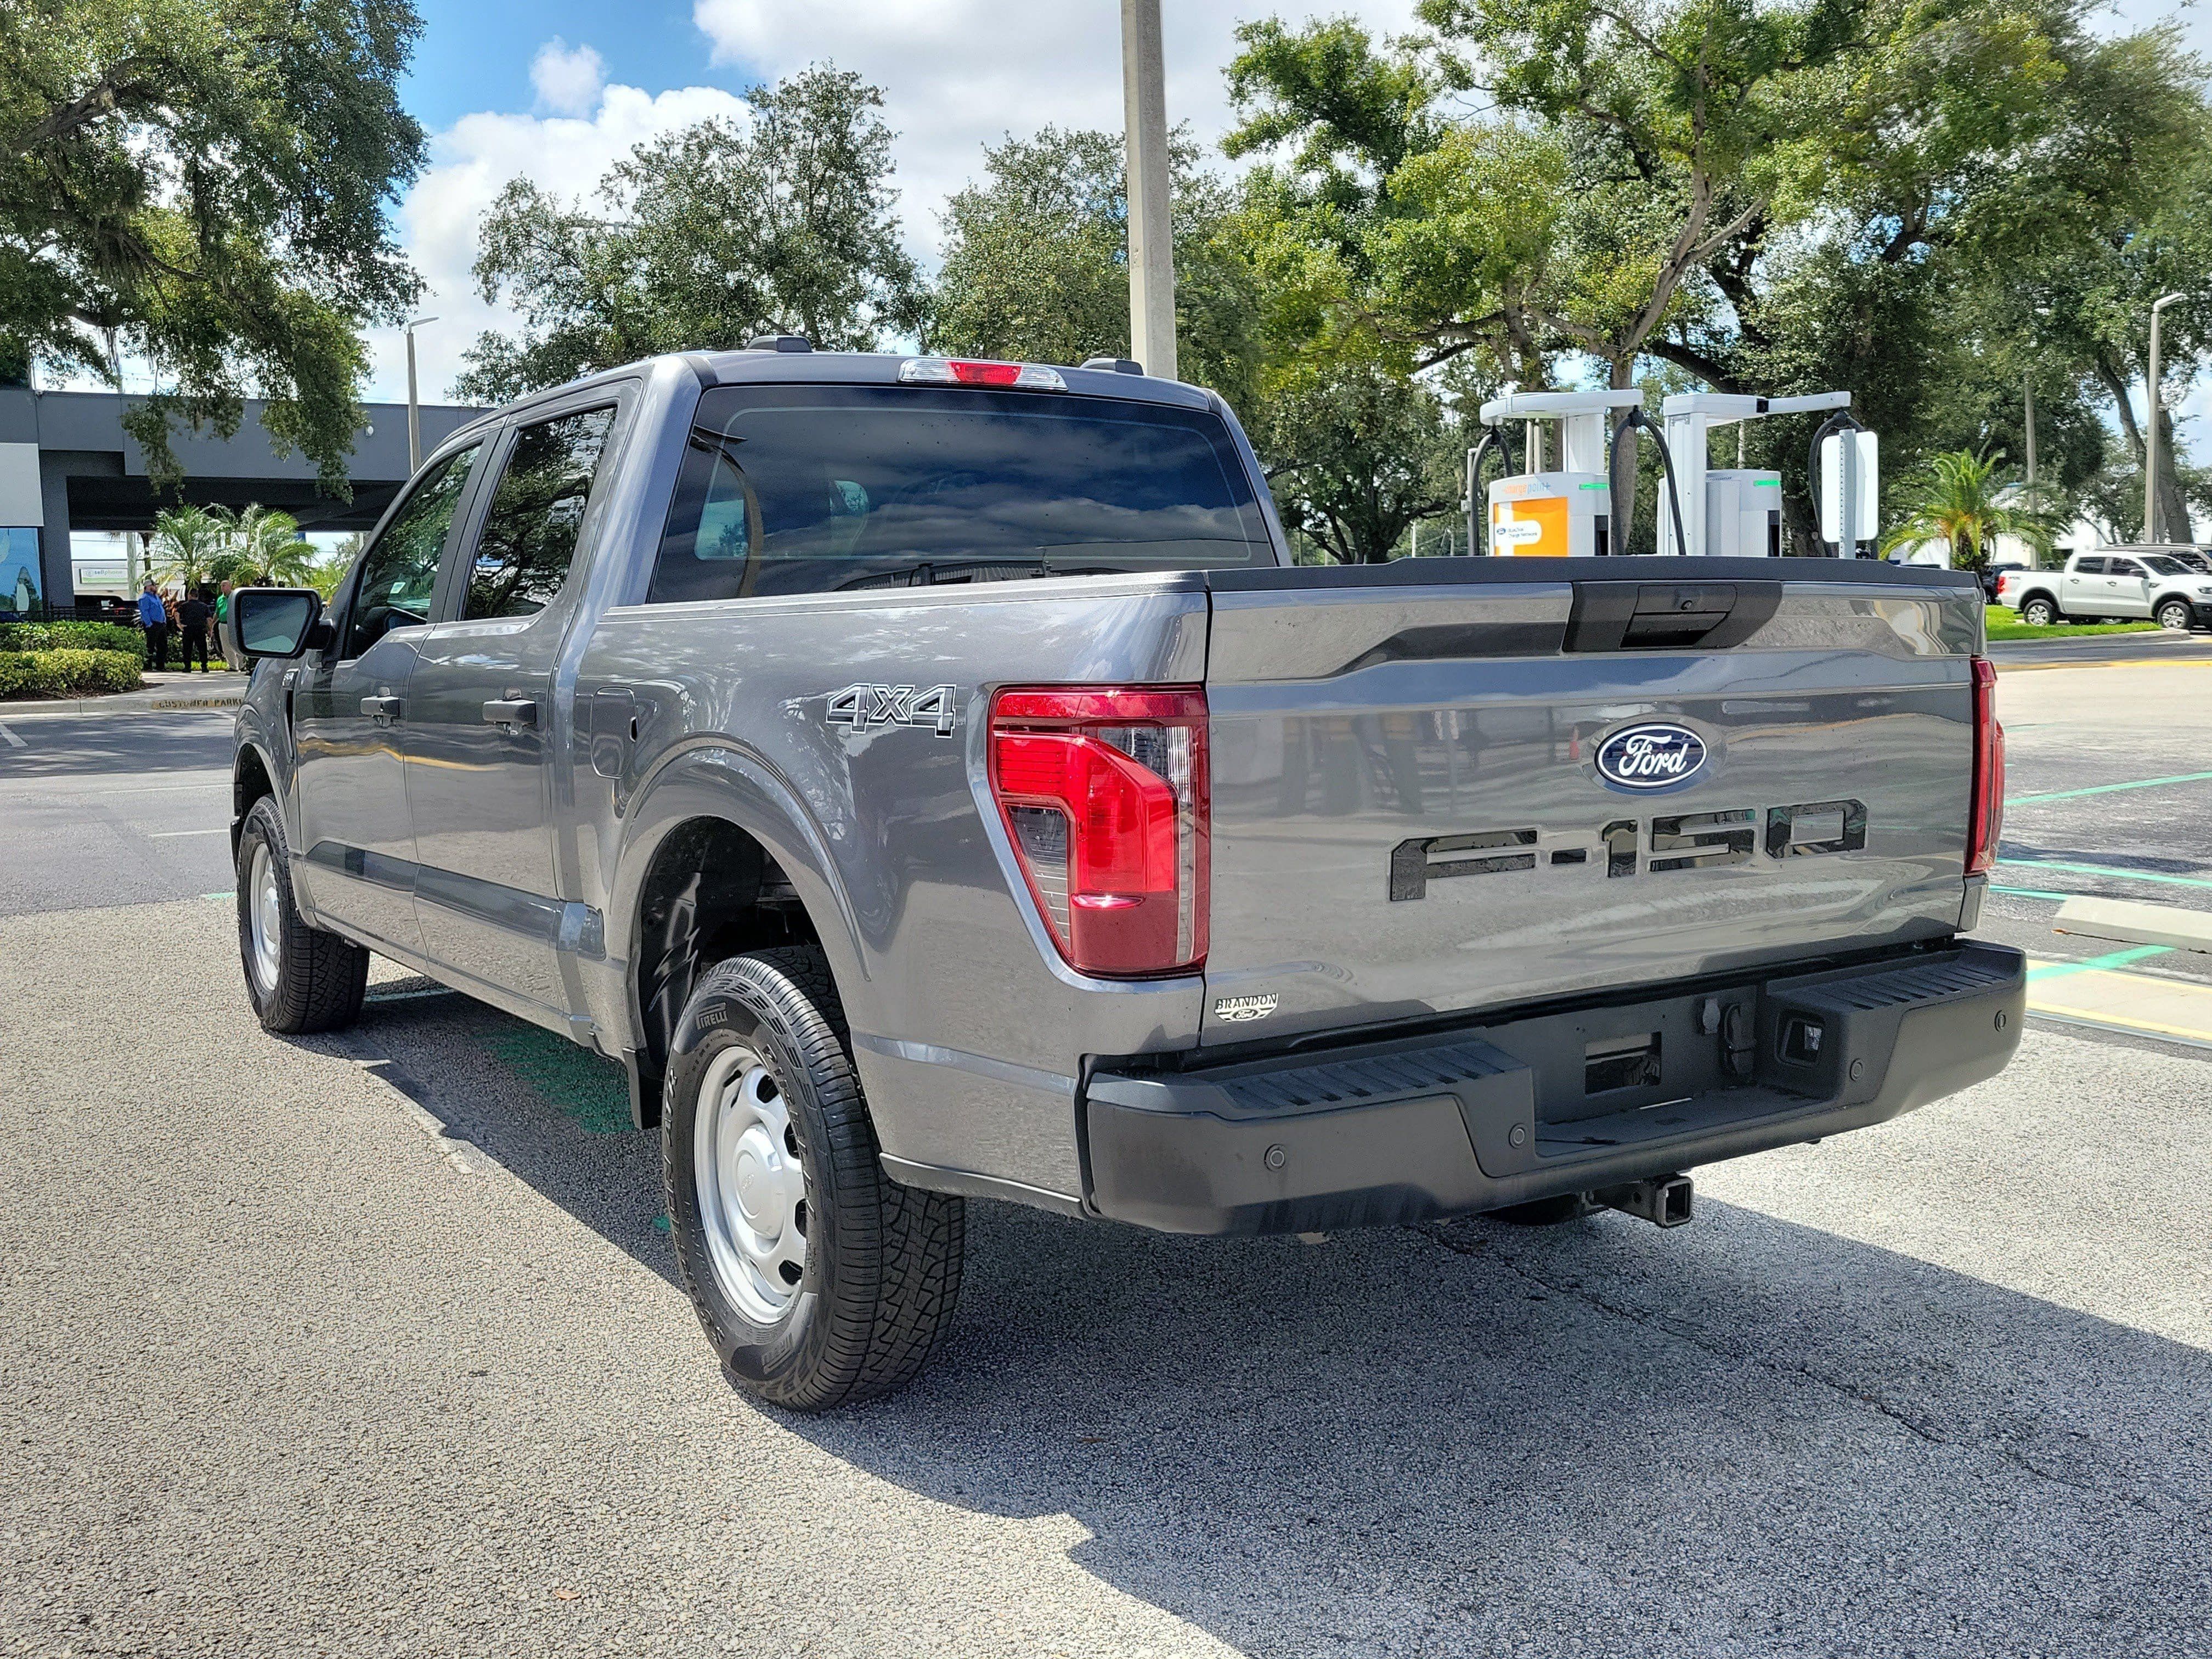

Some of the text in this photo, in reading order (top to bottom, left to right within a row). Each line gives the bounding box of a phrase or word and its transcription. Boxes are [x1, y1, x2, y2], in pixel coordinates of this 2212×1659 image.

[1618, 734, 1689, 776] Ford
[1389, 798, 1868, 901] F-150
[695, 1002, 728, 1030] PIRELLI
[1215, 993, 1278, 1009] BRANDON
